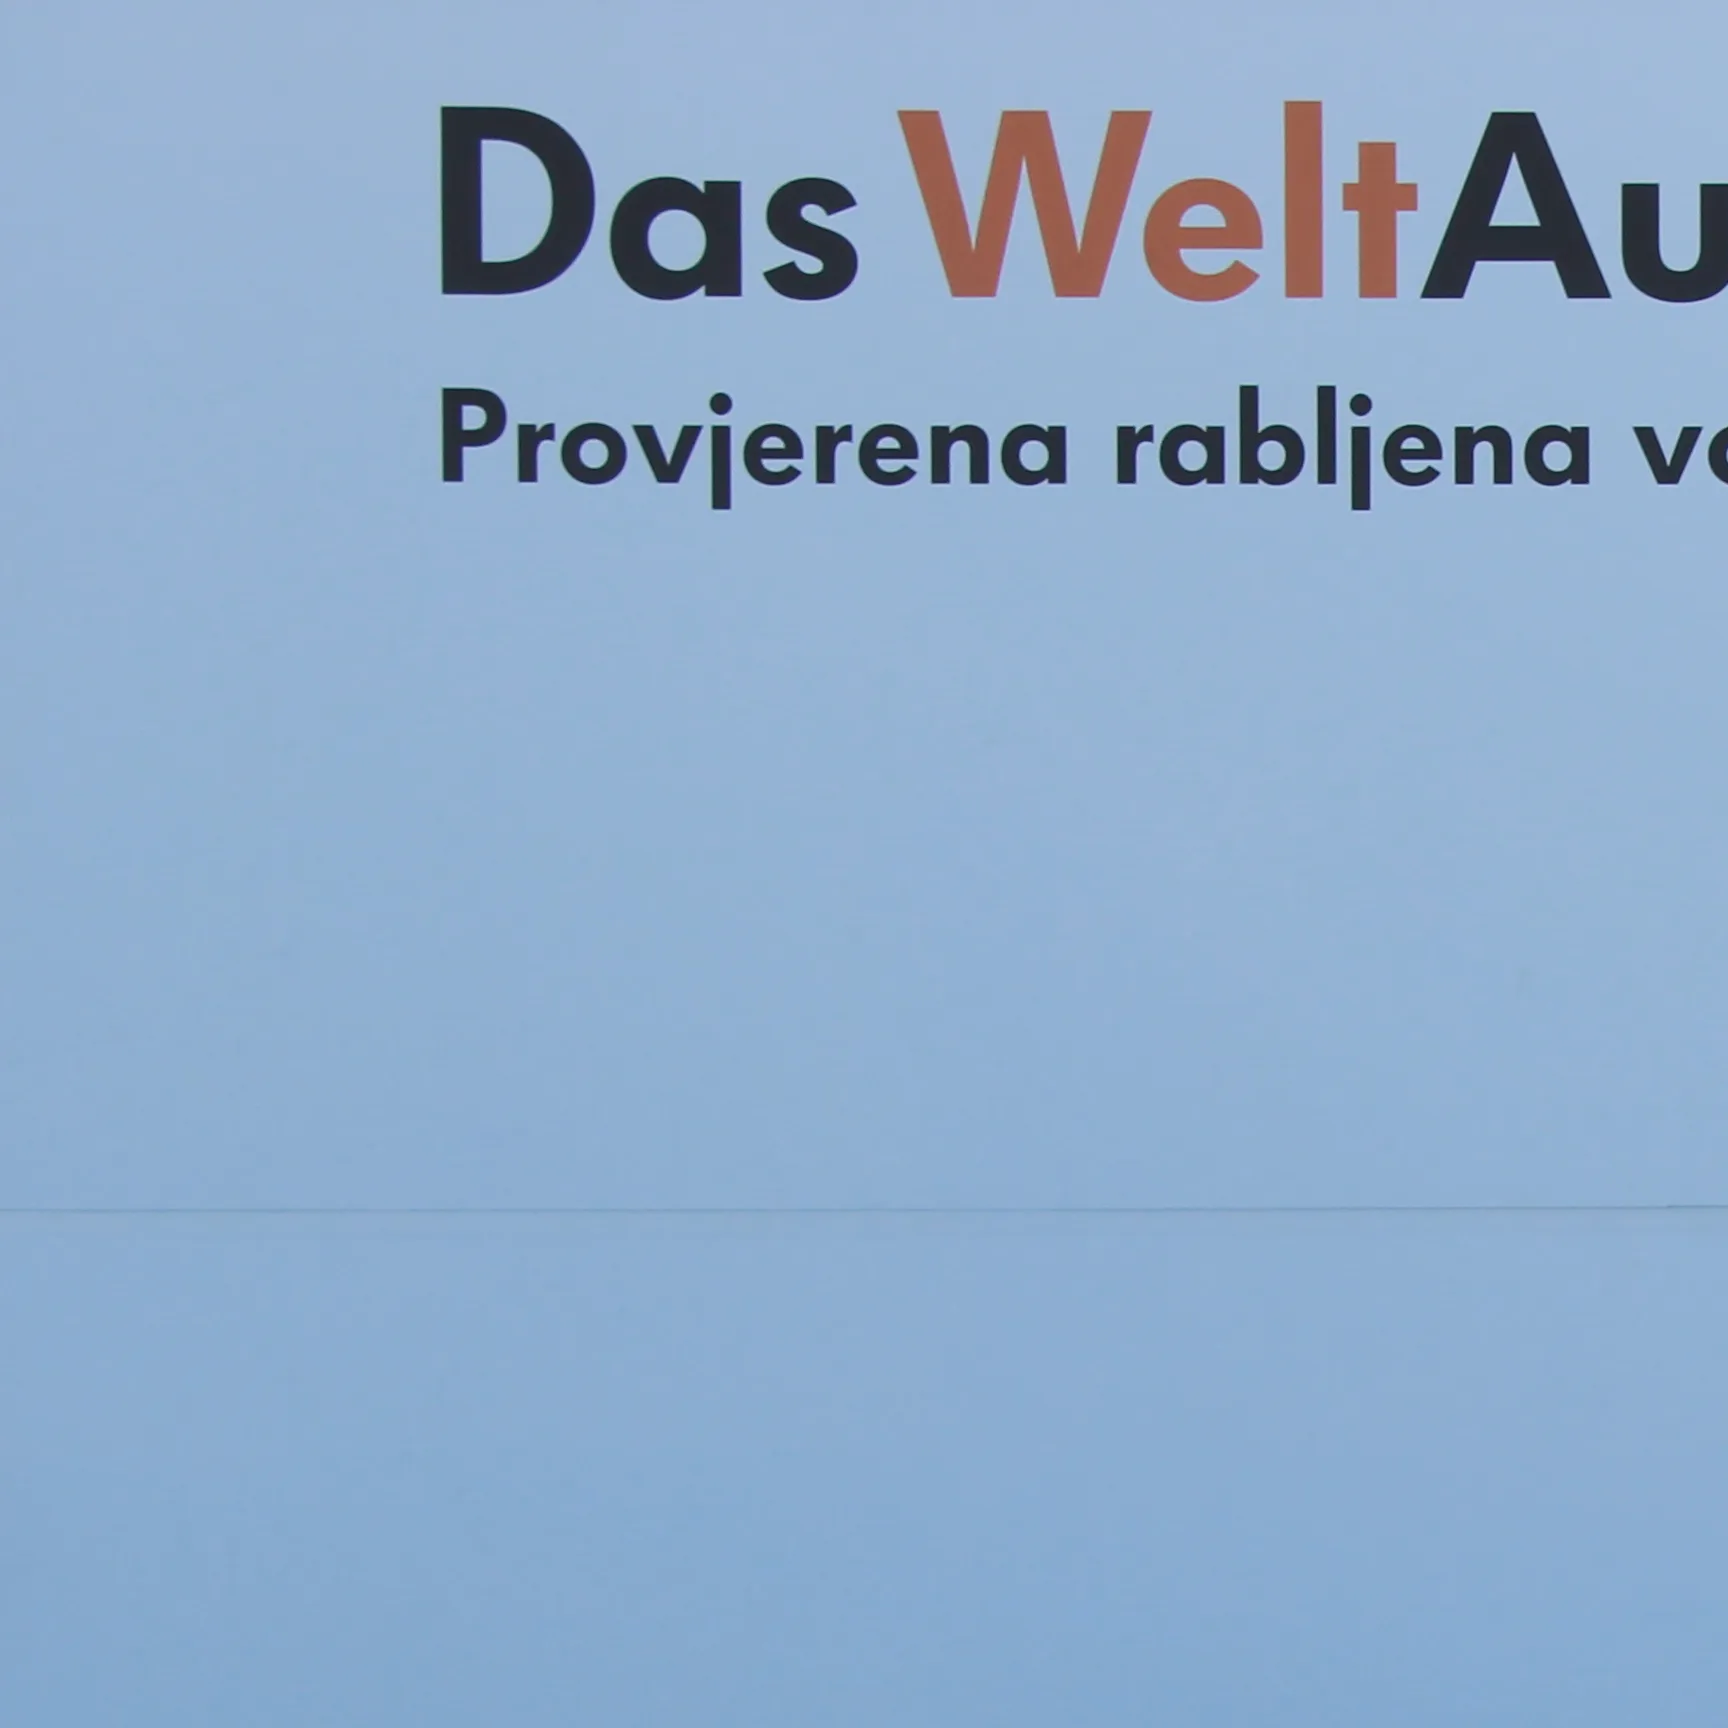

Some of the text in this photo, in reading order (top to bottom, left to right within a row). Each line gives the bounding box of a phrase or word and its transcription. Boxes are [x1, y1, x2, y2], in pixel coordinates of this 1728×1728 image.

[440, 105, 859, 301] Das
[441, 387, 1068, 510] Provjerena
[1116, 384, 1591, 511] rabljena
